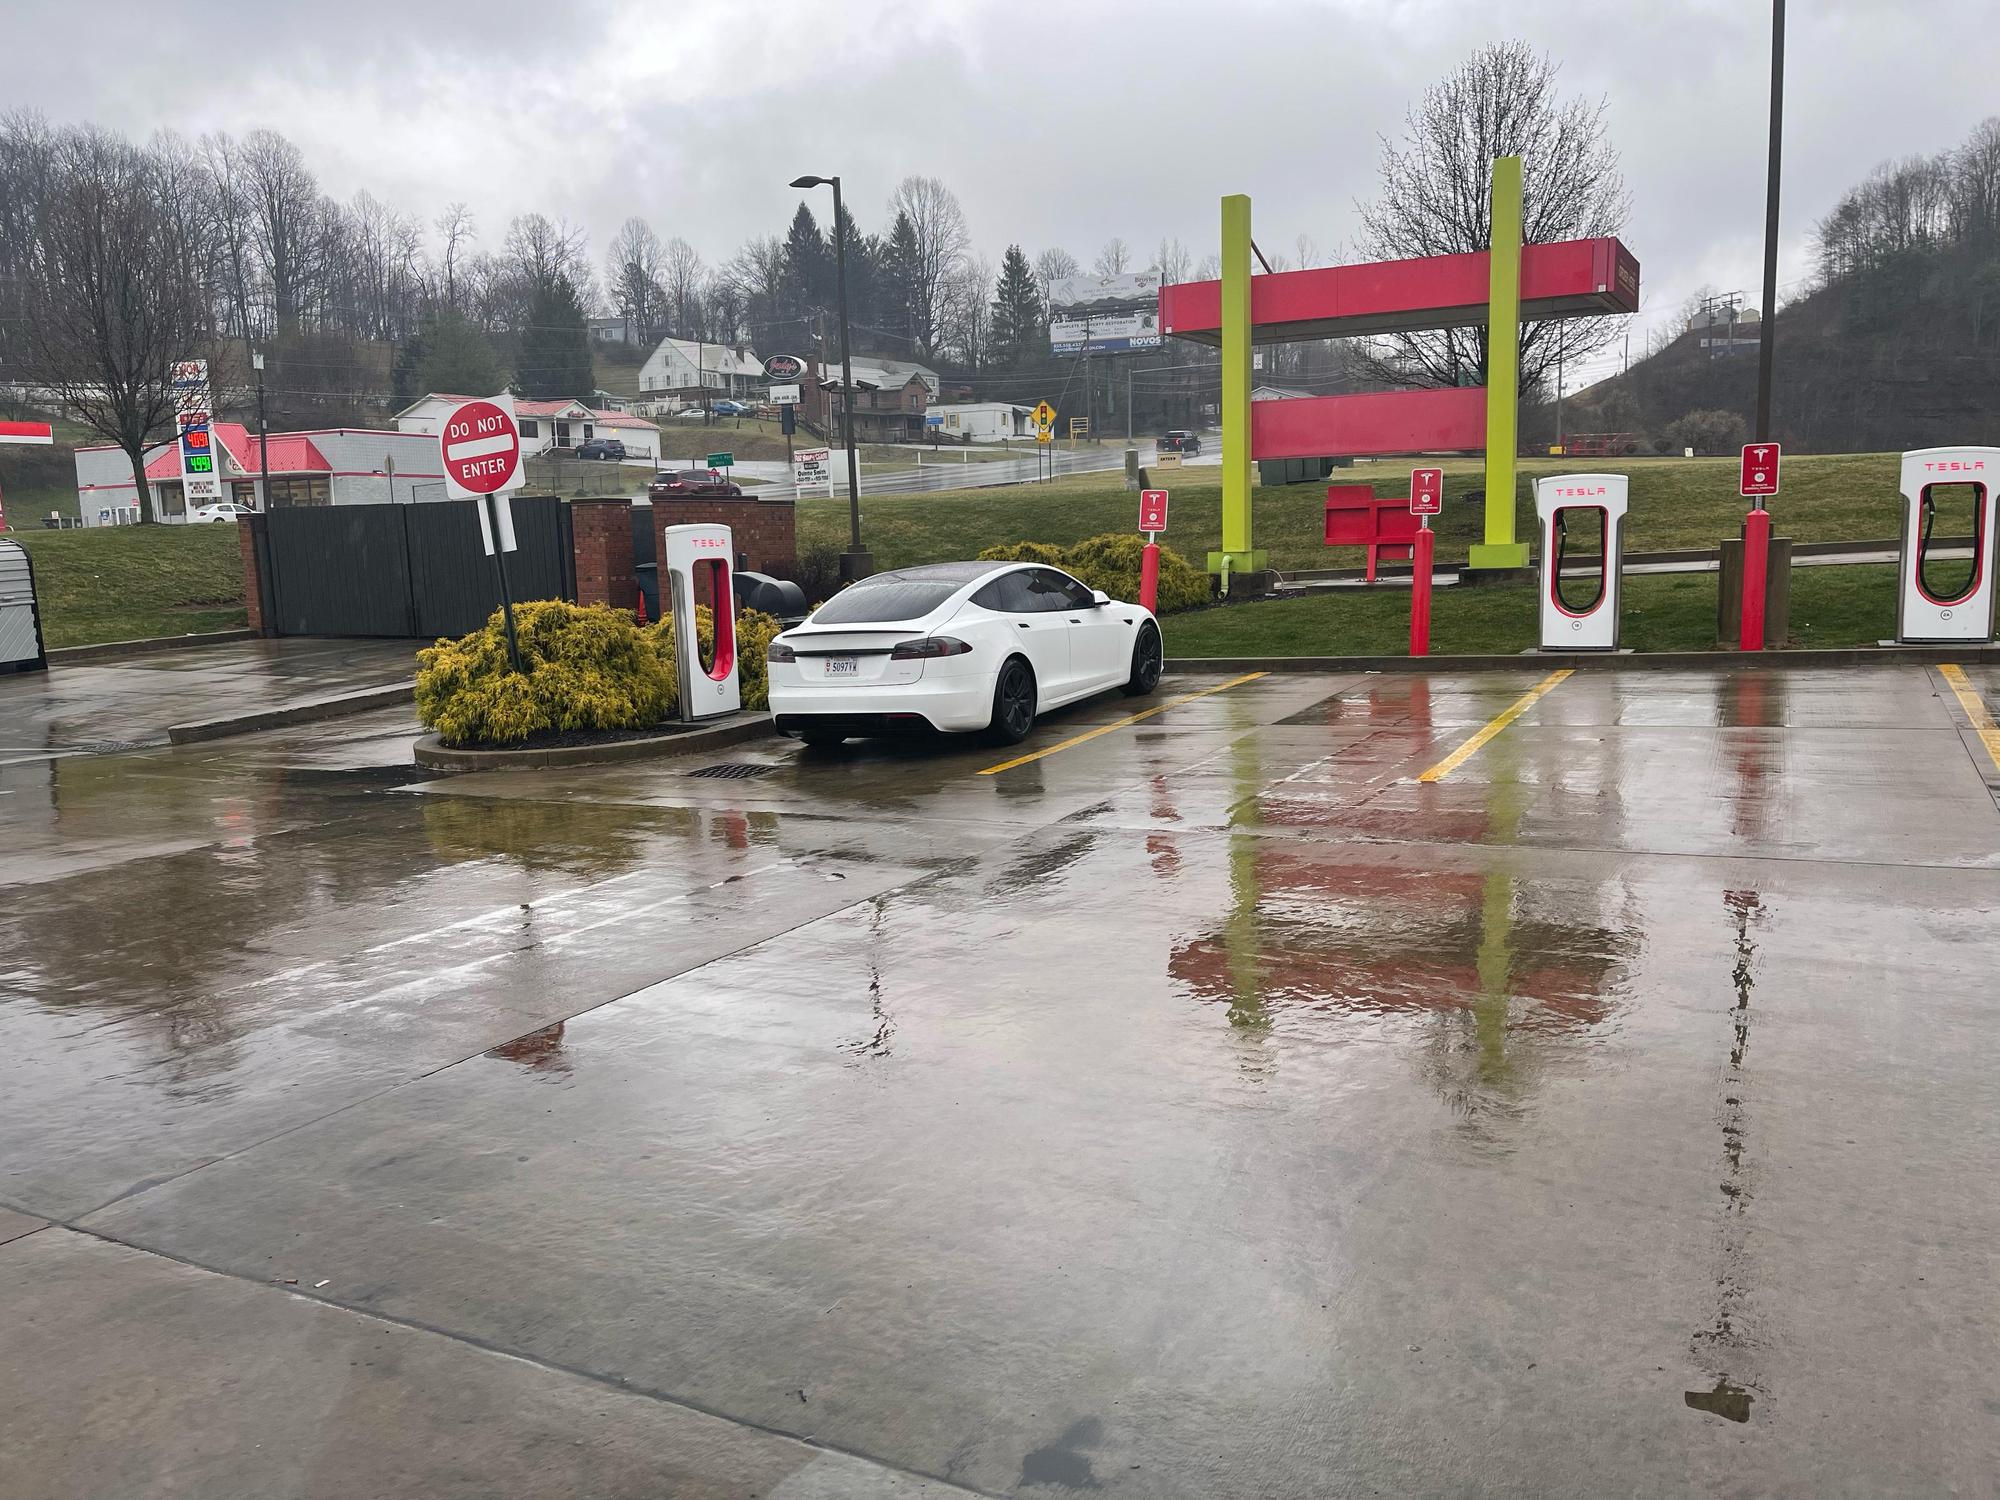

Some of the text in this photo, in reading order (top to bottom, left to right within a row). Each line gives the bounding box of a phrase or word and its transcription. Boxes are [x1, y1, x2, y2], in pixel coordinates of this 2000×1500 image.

[1129, 336, 1161, 346] NOVOS
[450, 415, 503, 438] DO NOT
[462, 458, 506, 479] ENTER
[1925, 461, 1984, 471] TESLA
[1556, 487, 1606, 496] TESLA
[691, 539, 725, 547] TESLA
